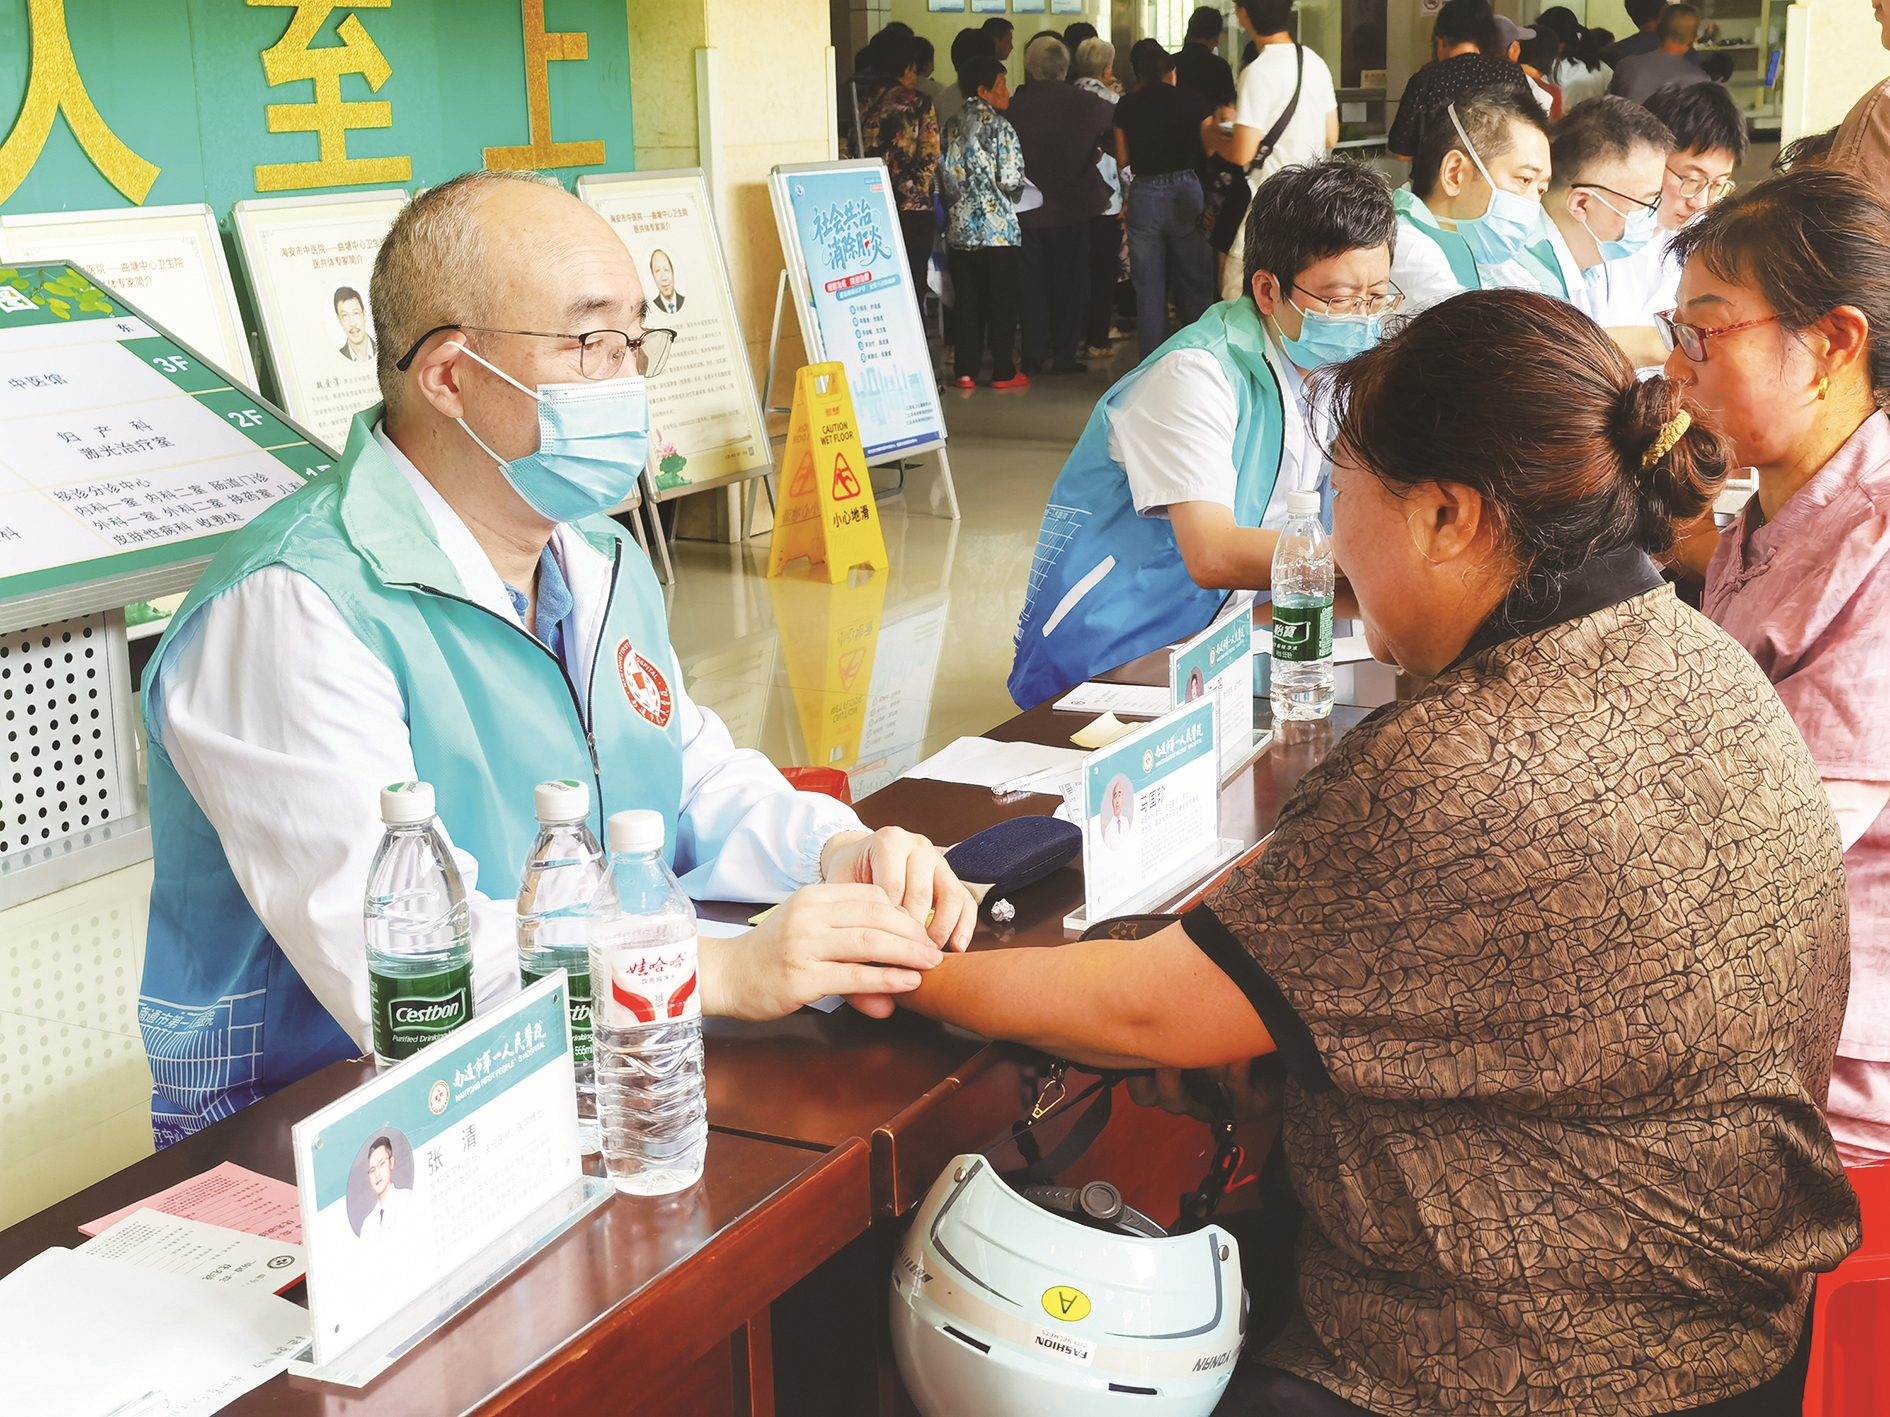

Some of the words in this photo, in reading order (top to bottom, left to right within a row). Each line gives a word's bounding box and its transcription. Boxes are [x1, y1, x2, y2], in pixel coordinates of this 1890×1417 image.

[811, 198, 874, 245] 社会共治
[152, 354, 190, 373] 3F
[8, 373, 69, 390] 中医馆
[228, 409, 263, 428] 2F
[822, 421, 848, 435] CAUTION
[78, 436, 175, 461] 激光治疗室
[820, 434, 833, 445] WET
[833, 430, 854, 443] FLOOR
[74, 497, 142, 517] 内科一室
[144, 485, 208, 504] 内科二室
[208, 472, 269, 491] 肠道门诊
[93, 511, 161, 531] 外科一室
[163, 497, 227, 518] 外科二室
[833, 504, 869, 528] 小心地滑
[112, 521, 193, 546] 皮肤性病科
[194, 511, 245, 529] 收费处
[626, 952, 686, 976] 娃哈哈
[392, 1034, 419, 1043] Purified
[427, 1123, 477, 1177] 张清
[1058, 1291, 1078, 1315] A
[1034, 1335, 1088, 1360] FASHION
